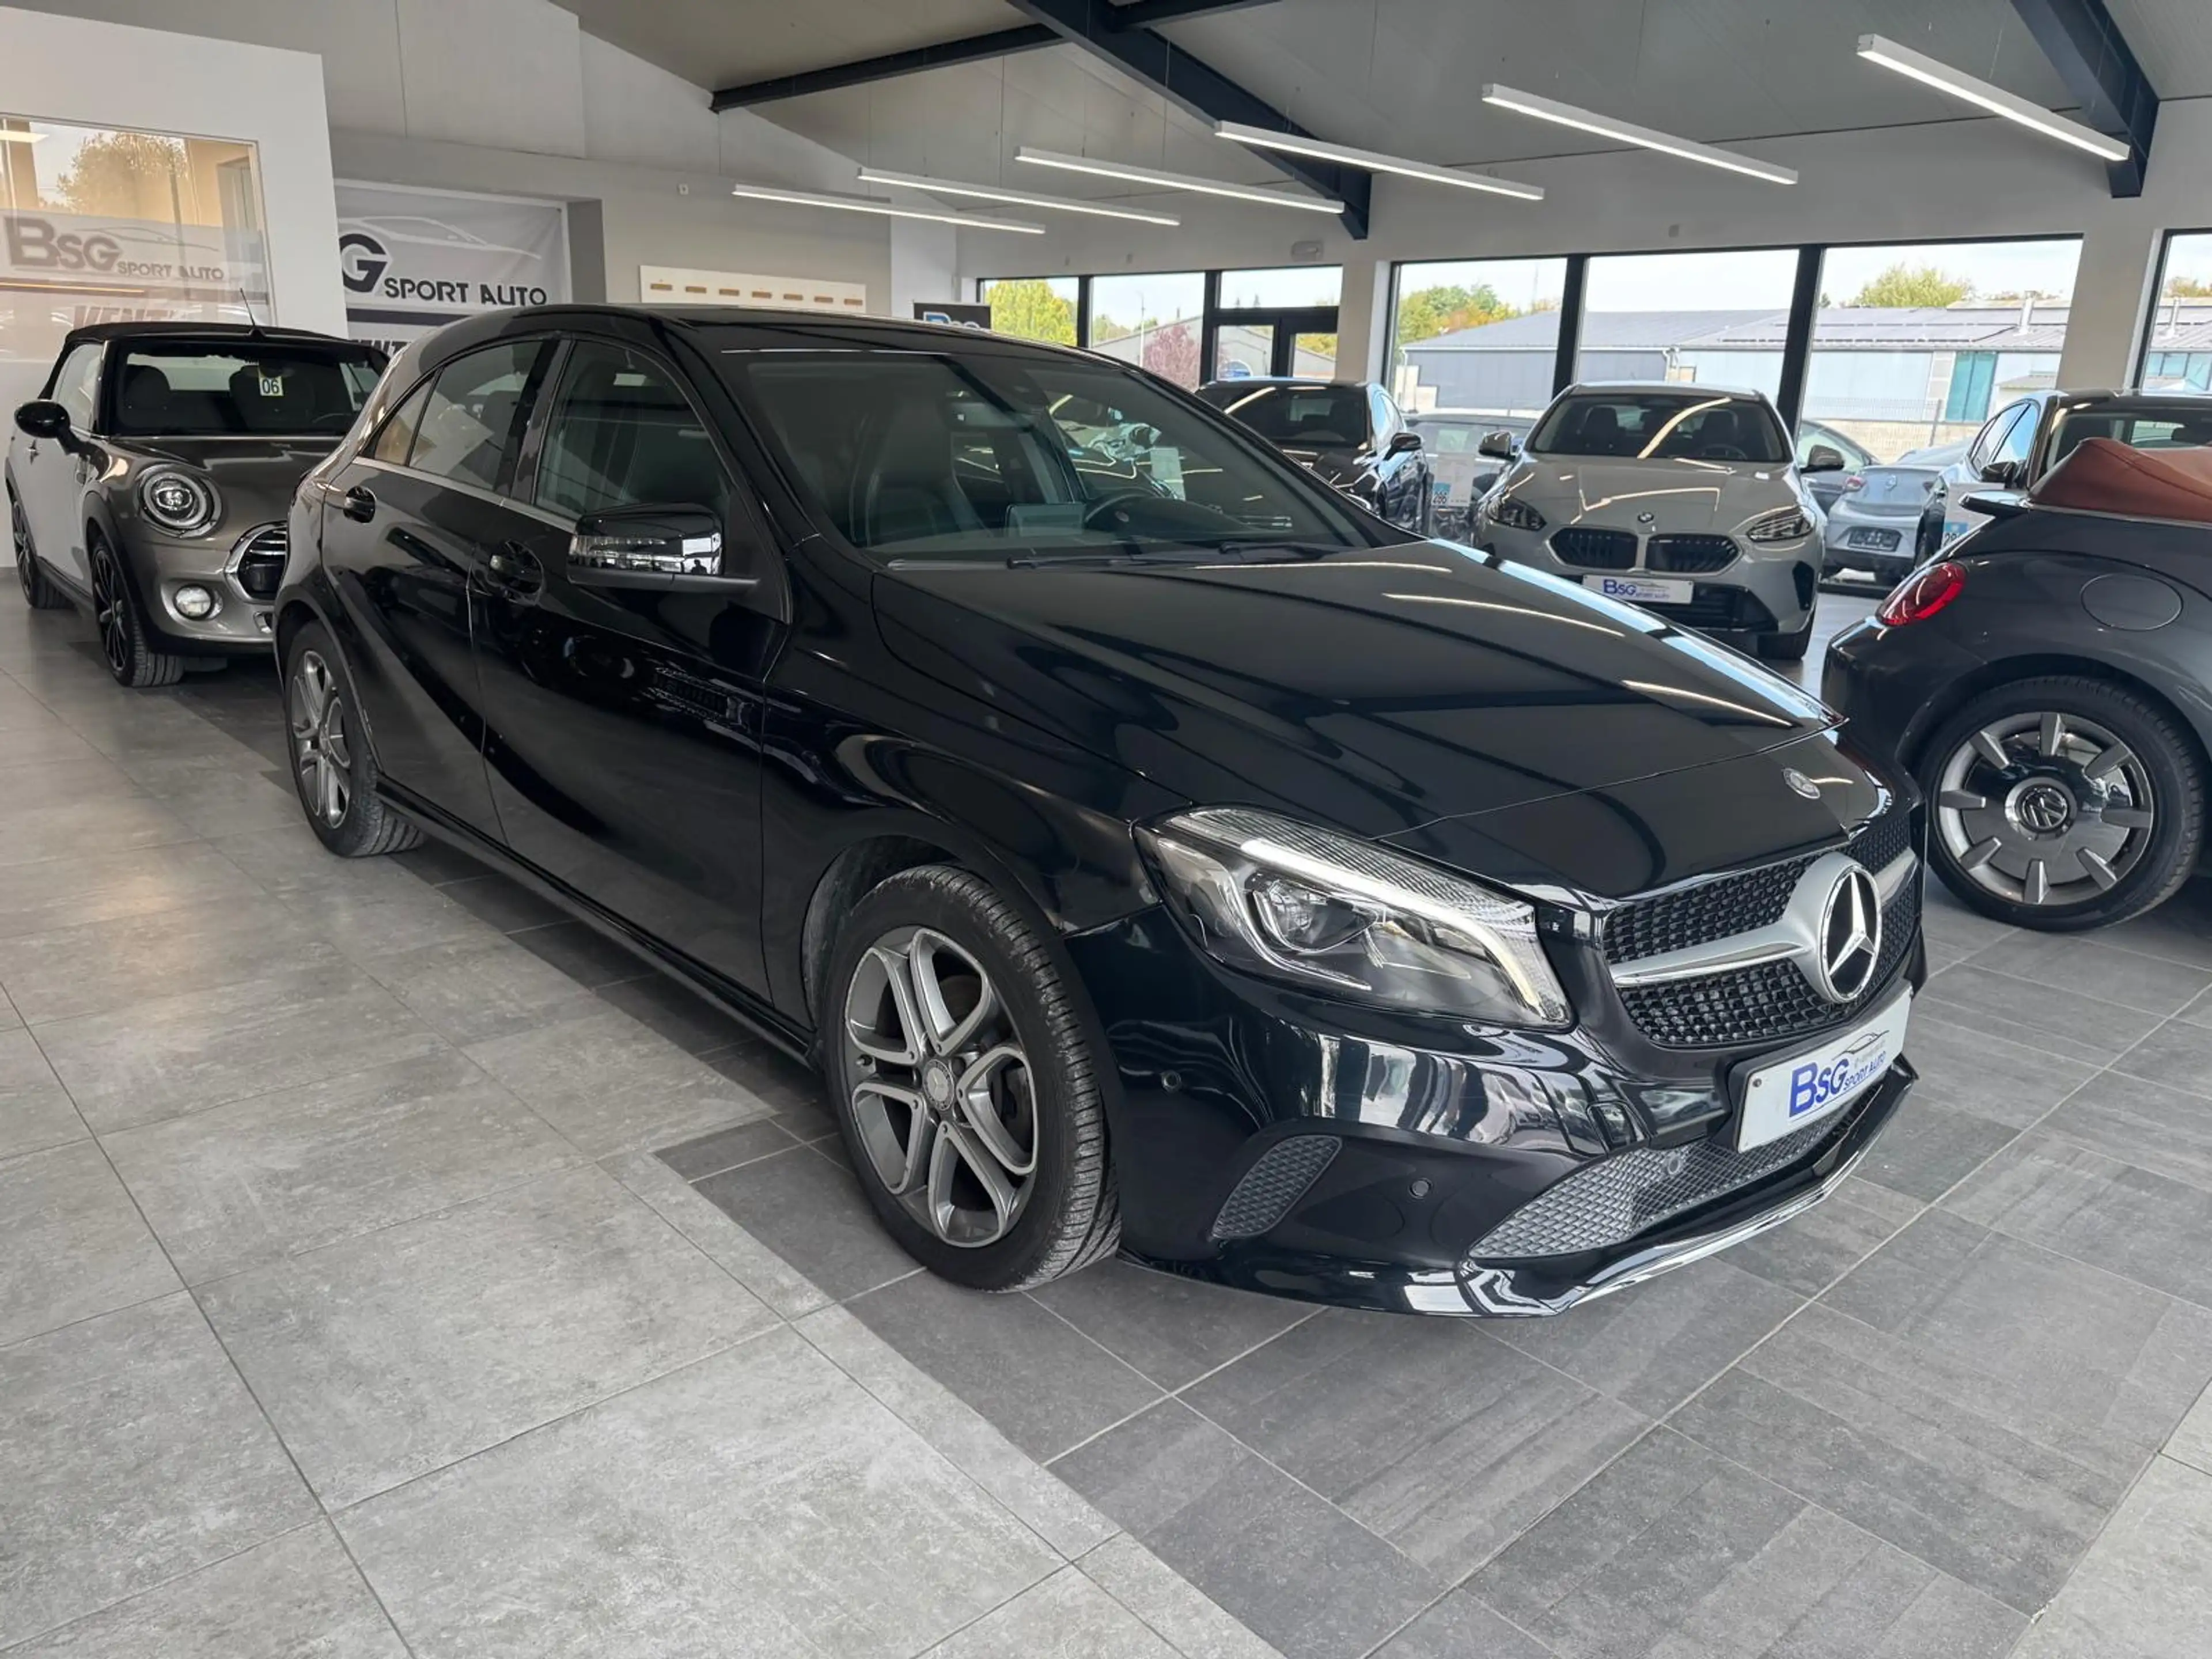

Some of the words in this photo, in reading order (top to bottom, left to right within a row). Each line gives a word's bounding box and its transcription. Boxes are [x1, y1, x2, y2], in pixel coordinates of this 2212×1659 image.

[118, 261, 172, 278] SPORT
[179, 265, 224, 280] AUTO
[384, 278, 468, 303] SPORT
[480, 284, 547, 306] AUTO
[263, 379, 280, 394] 06
